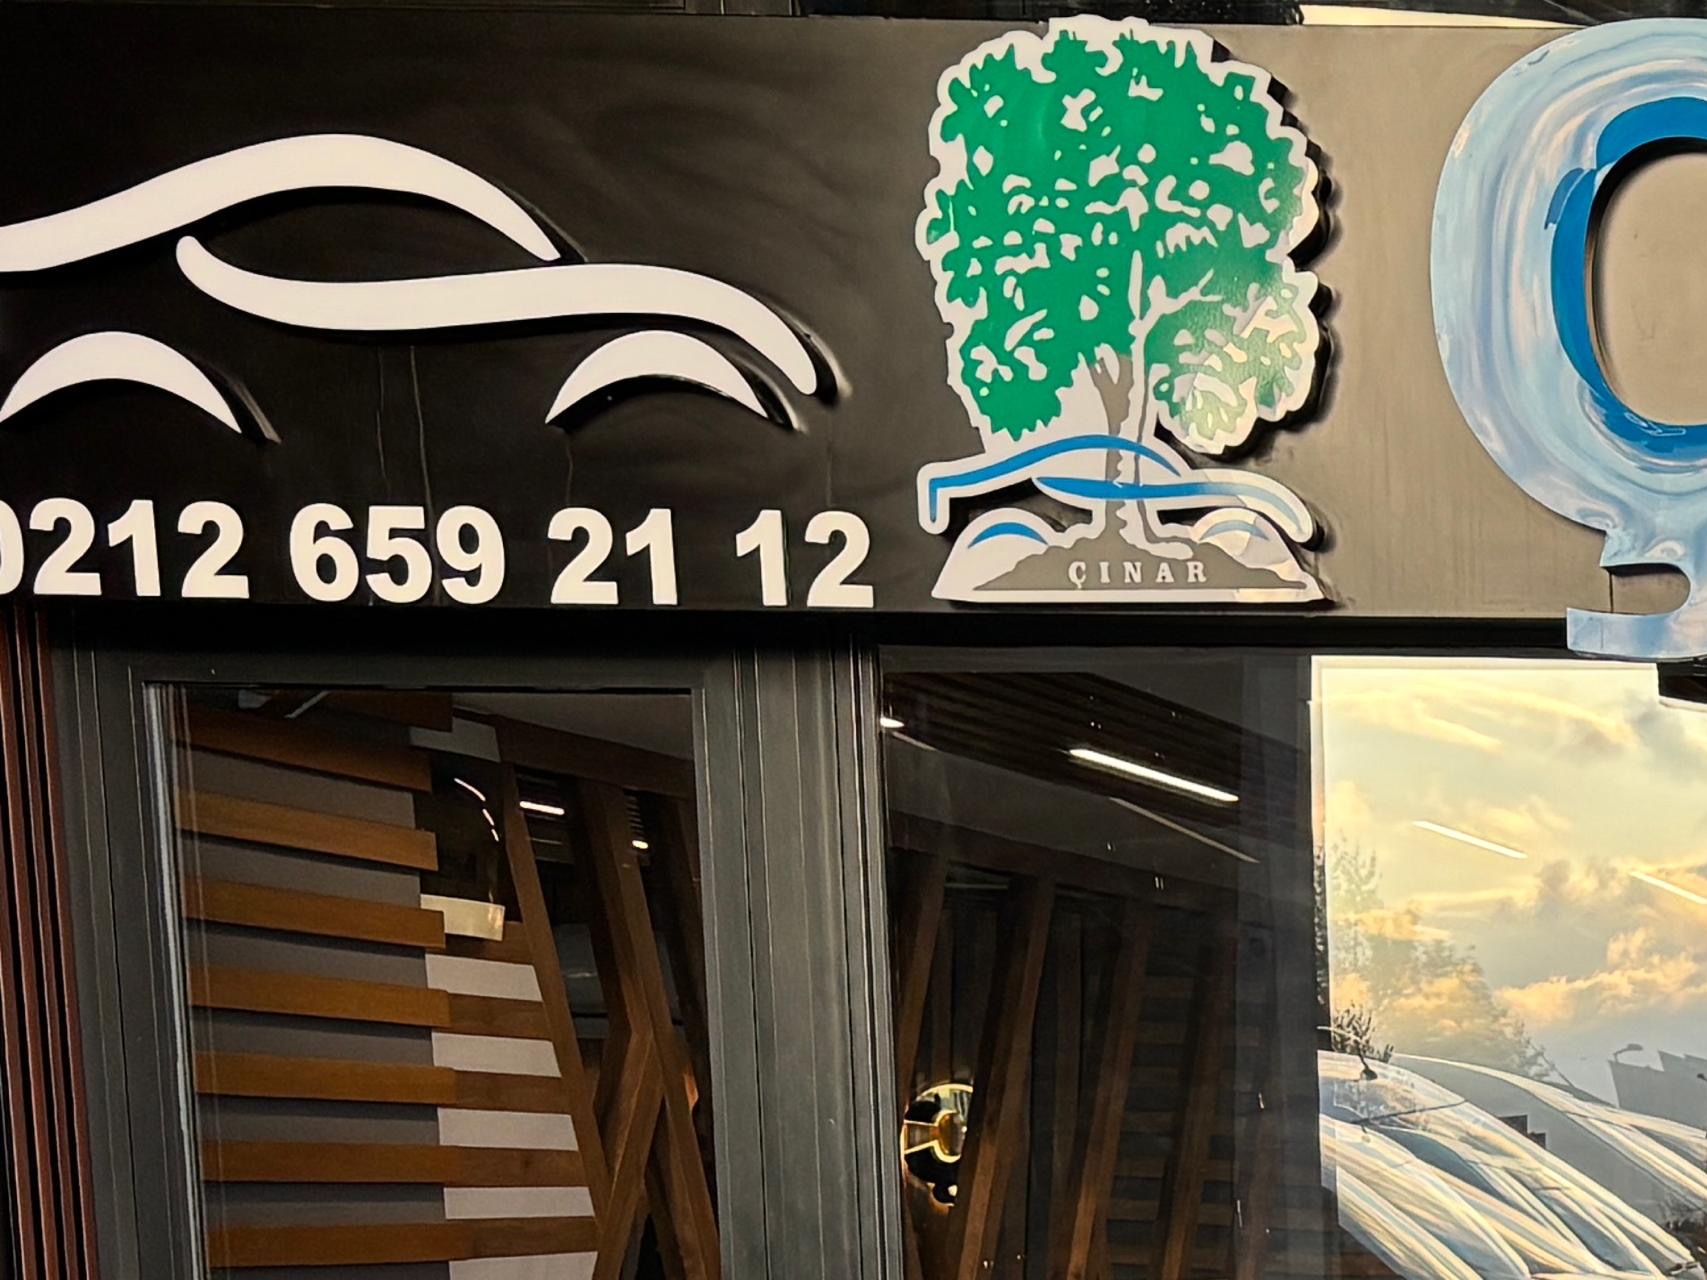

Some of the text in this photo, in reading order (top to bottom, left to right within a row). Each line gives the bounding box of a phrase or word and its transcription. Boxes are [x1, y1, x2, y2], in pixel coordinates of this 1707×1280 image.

[290, 503, 506, 604] 659
[547, 508, 679, 605] 21
[735, 509, 874, 608] 12
[1068, 561, 1207, 589] ÇINAR
